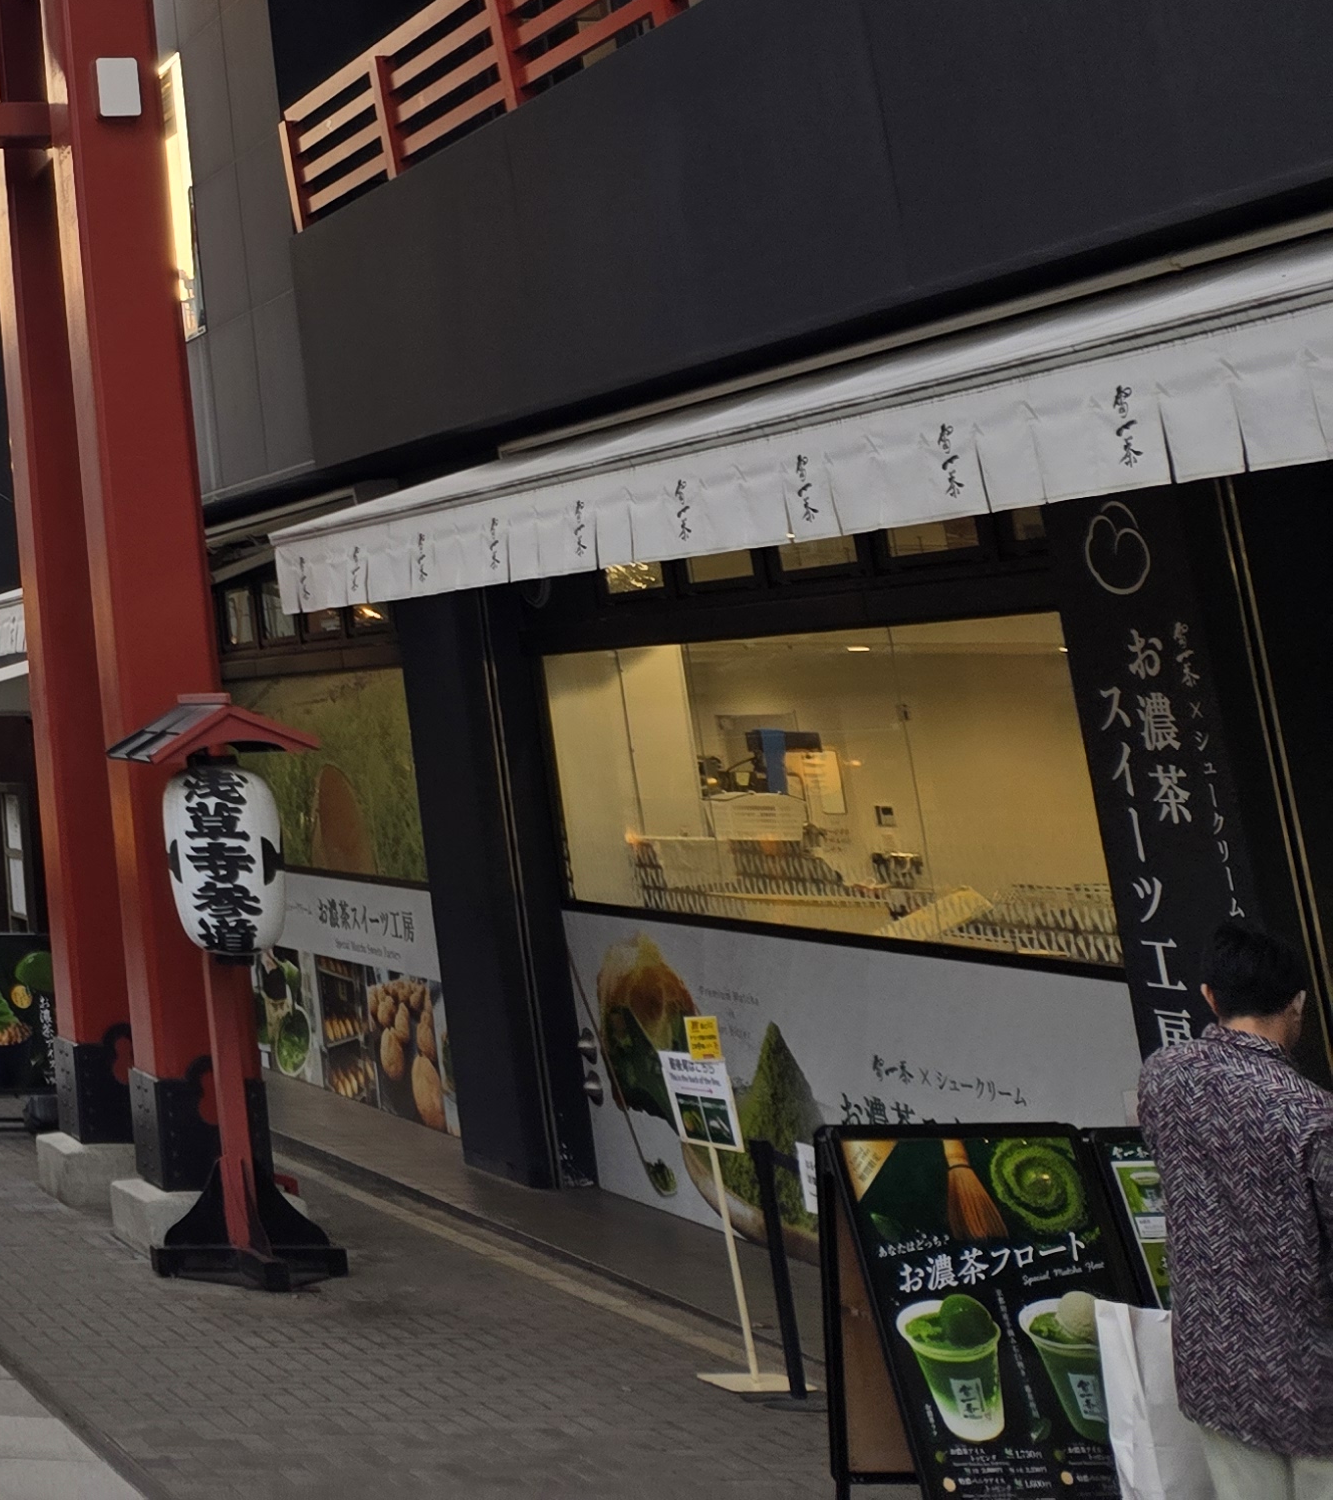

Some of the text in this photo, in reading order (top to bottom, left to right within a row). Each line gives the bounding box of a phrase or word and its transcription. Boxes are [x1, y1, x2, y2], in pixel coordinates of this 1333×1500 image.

[317, 896, 415, 943] お濃茶スイーツ工房
[898, 1231, 1087, 1294] お濃茶フロート
